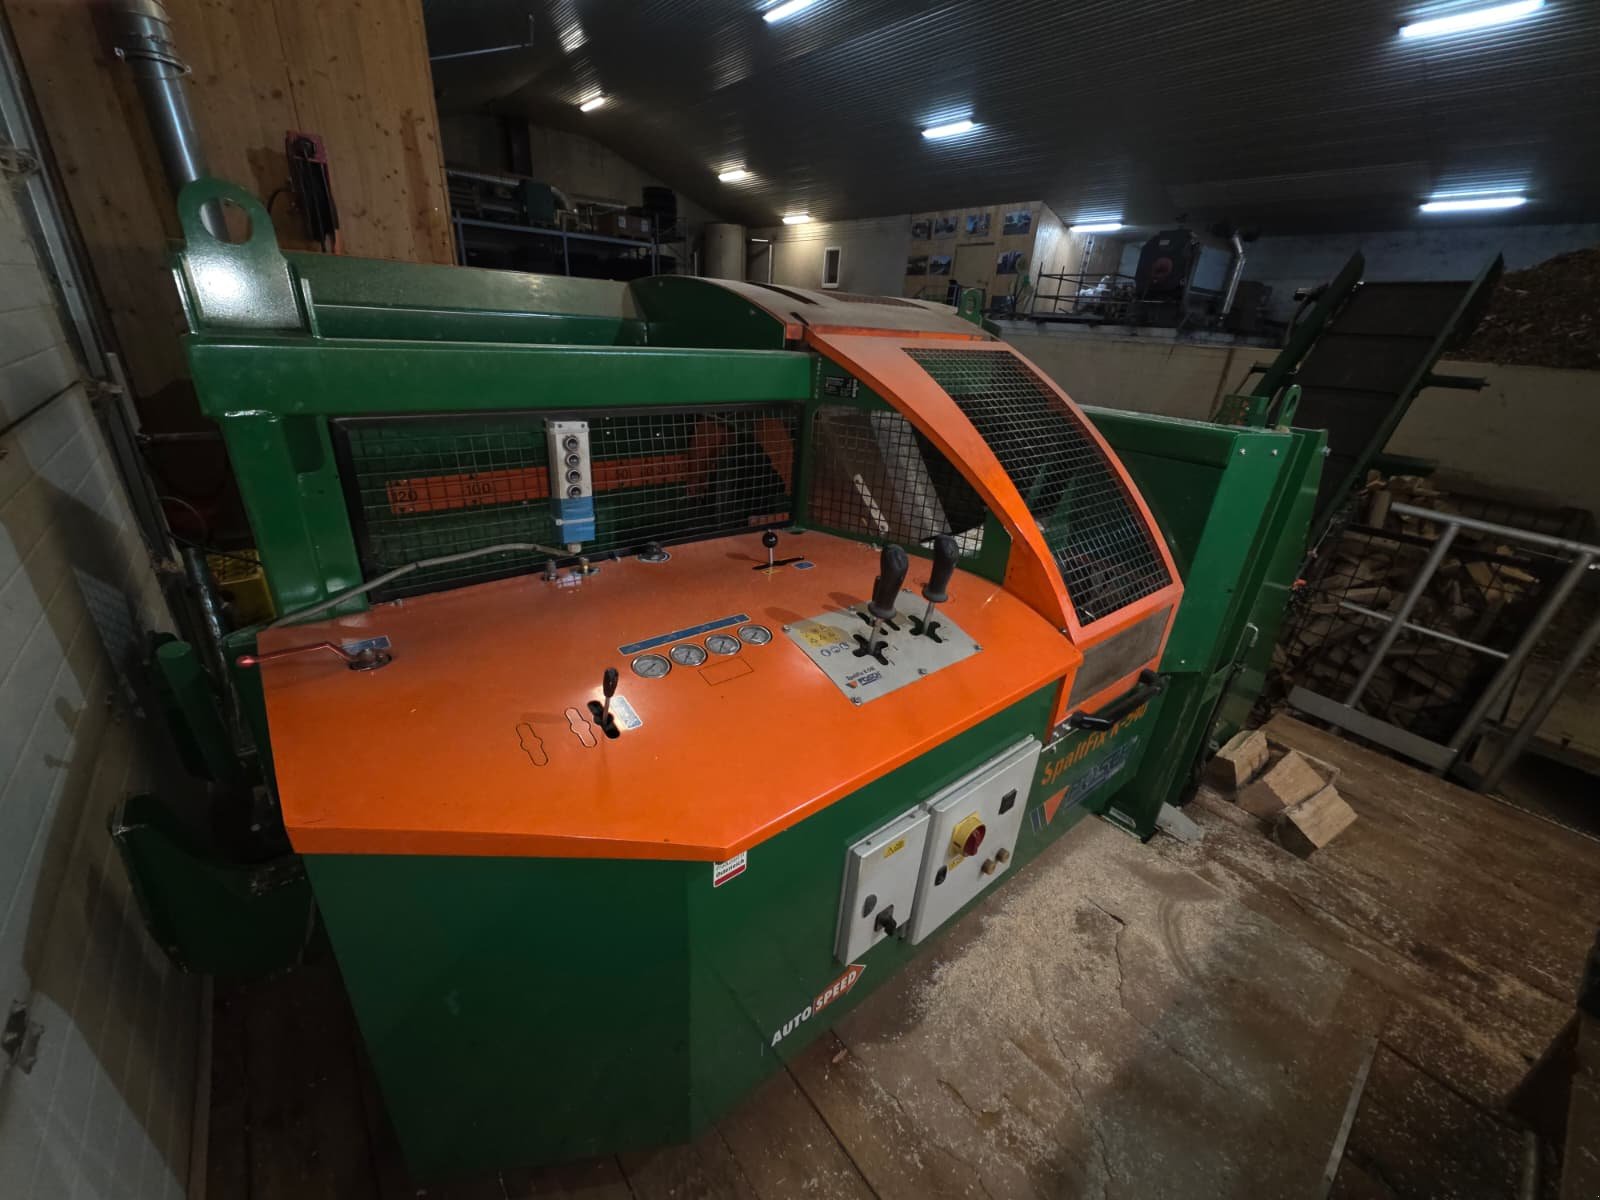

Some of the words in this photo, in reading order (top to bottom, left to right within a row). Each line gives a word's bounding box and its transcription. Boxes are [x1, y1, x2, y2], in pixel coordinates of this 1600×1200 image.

[466, 483, 491, 497] 100
[770, 1006, 812, 1047] AUTO
[814, 970, 857, 1011] SPEED
